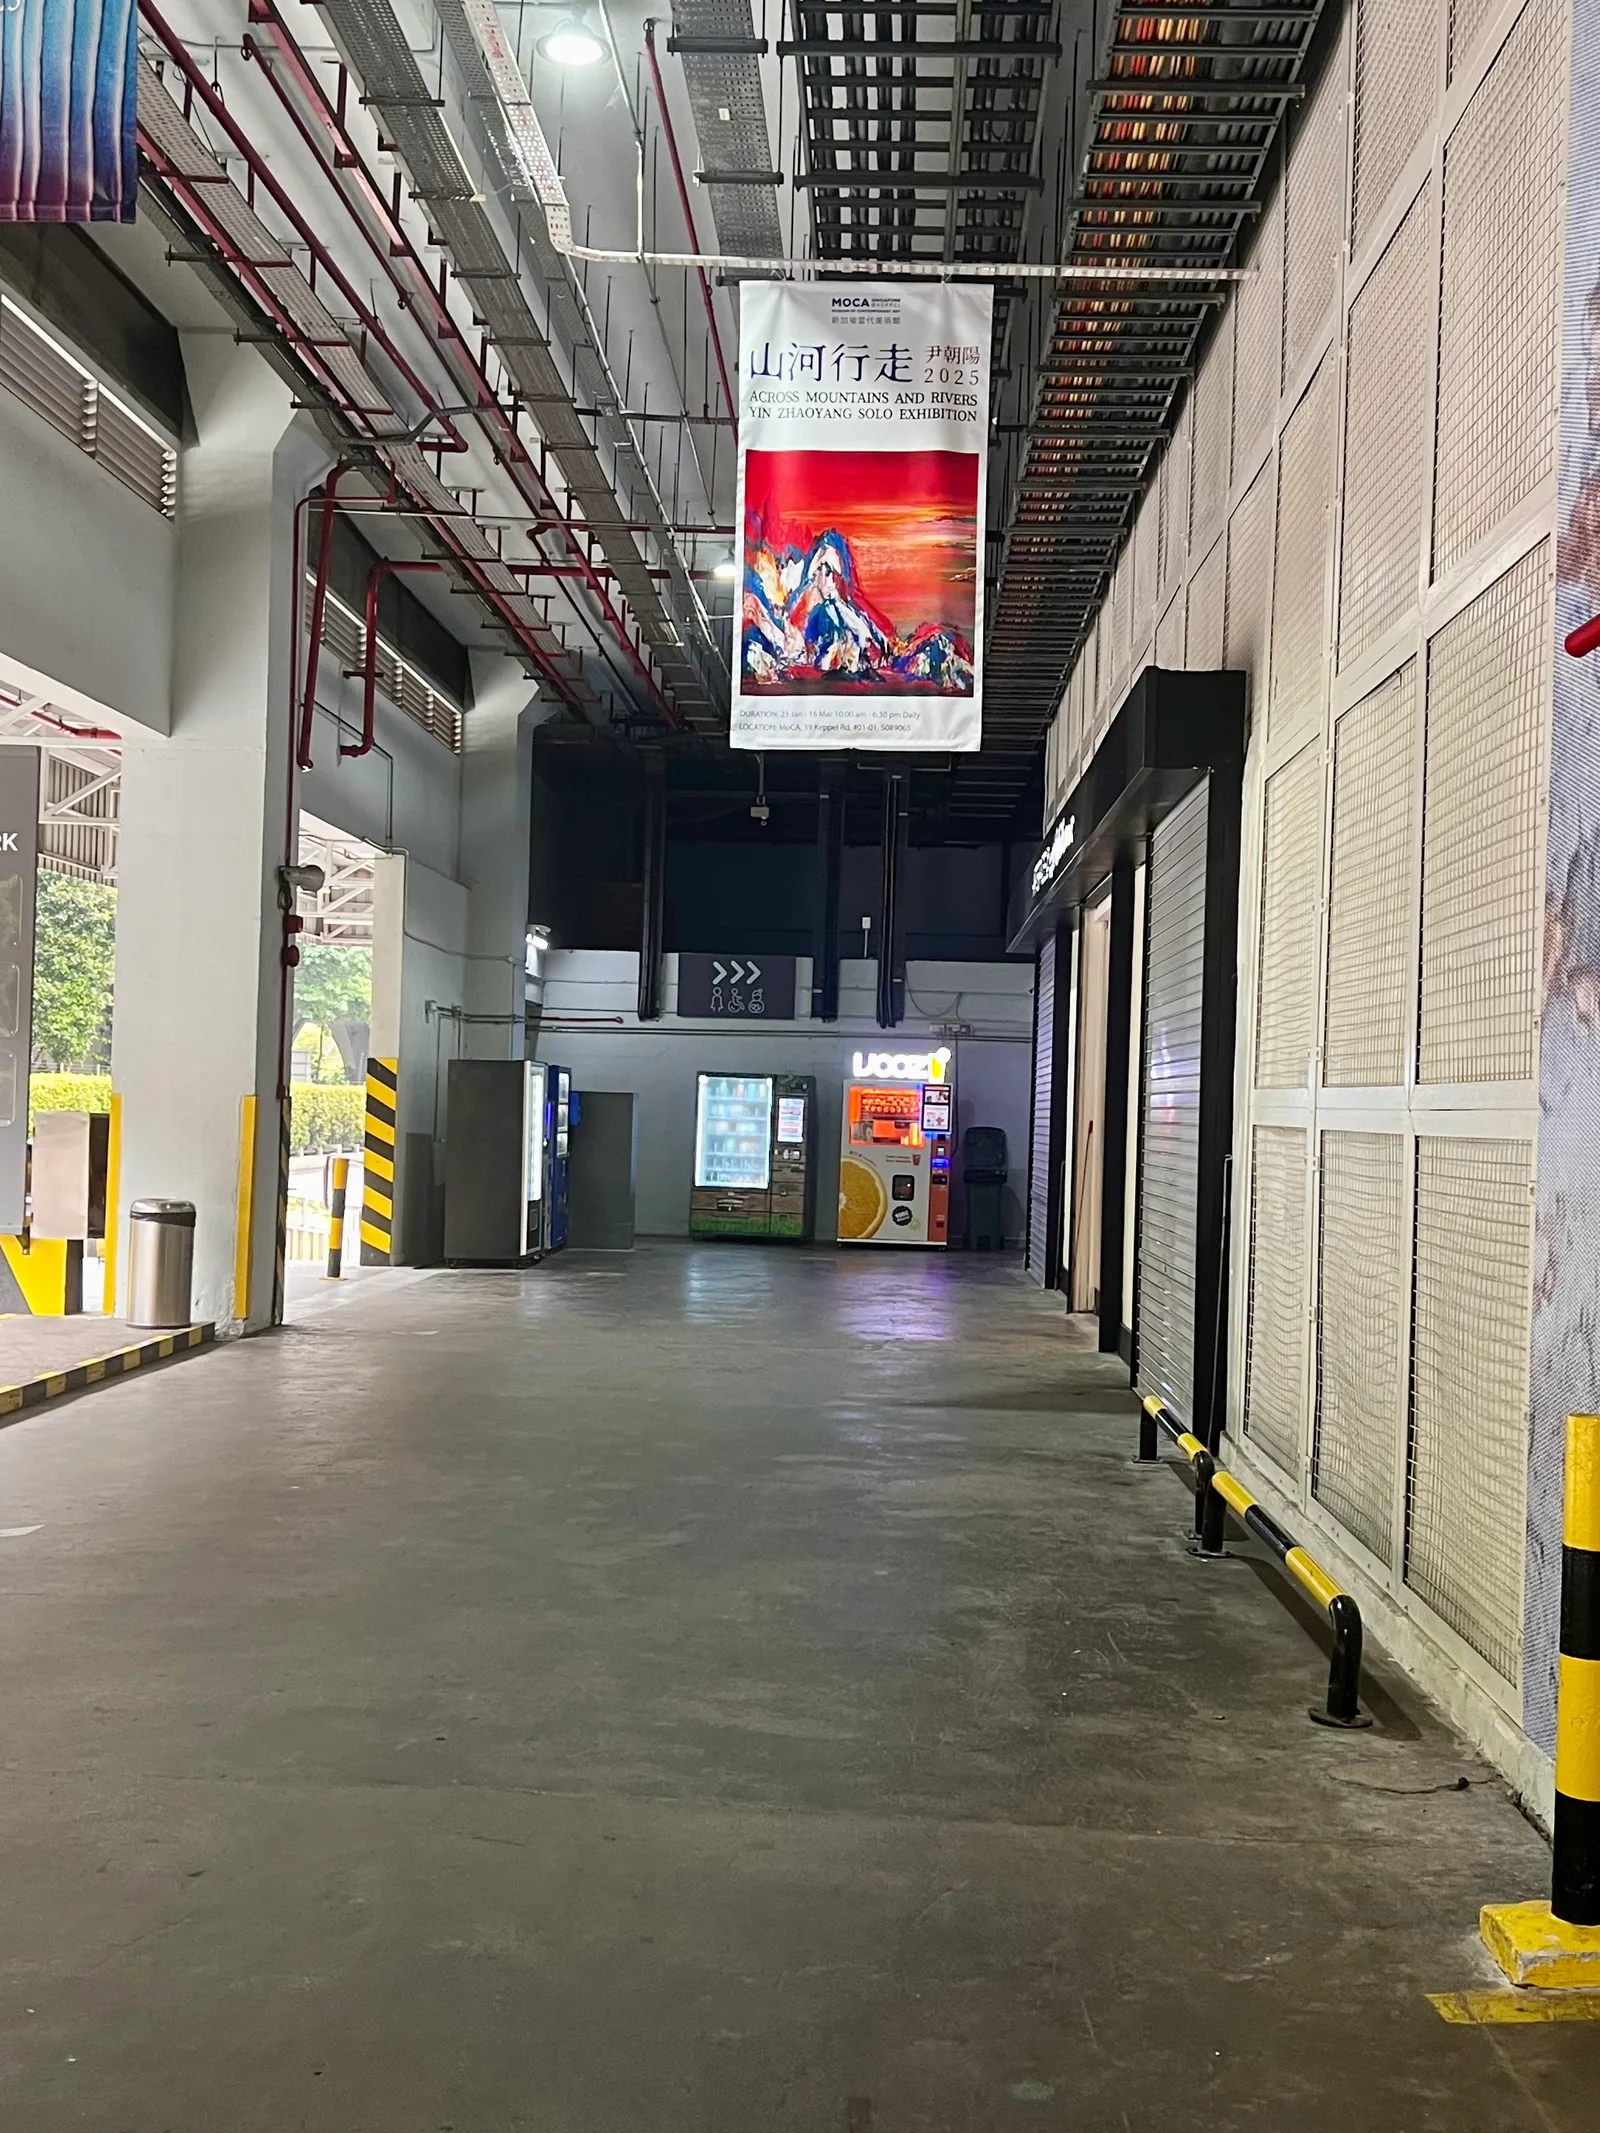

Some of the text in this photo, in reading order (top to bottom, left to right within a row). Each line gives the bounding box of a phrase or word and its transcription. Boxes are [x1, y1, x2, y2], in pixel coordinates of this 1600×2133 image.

[831, 298, 870, 307] MOCA
[750, 342, 913, 383] 山河行走
[924, 345, 980, 365] 尹朝陽
[924, 368, 979, 386] 2025
[750, 390, 978, 406] ACROSS MOUNTAINS AND RIVERS
[750, 406, 977, 422] YIN ZHAOYANG SOLO EXHIBITION
[739, 710, 777, 718] DURATION:
[902, 711, 921, 720] Daily
[739, 723, 776, 731] LOCATION:
[814, 724, 839, 732] Keppel
[0, 832, 18, 851] K
